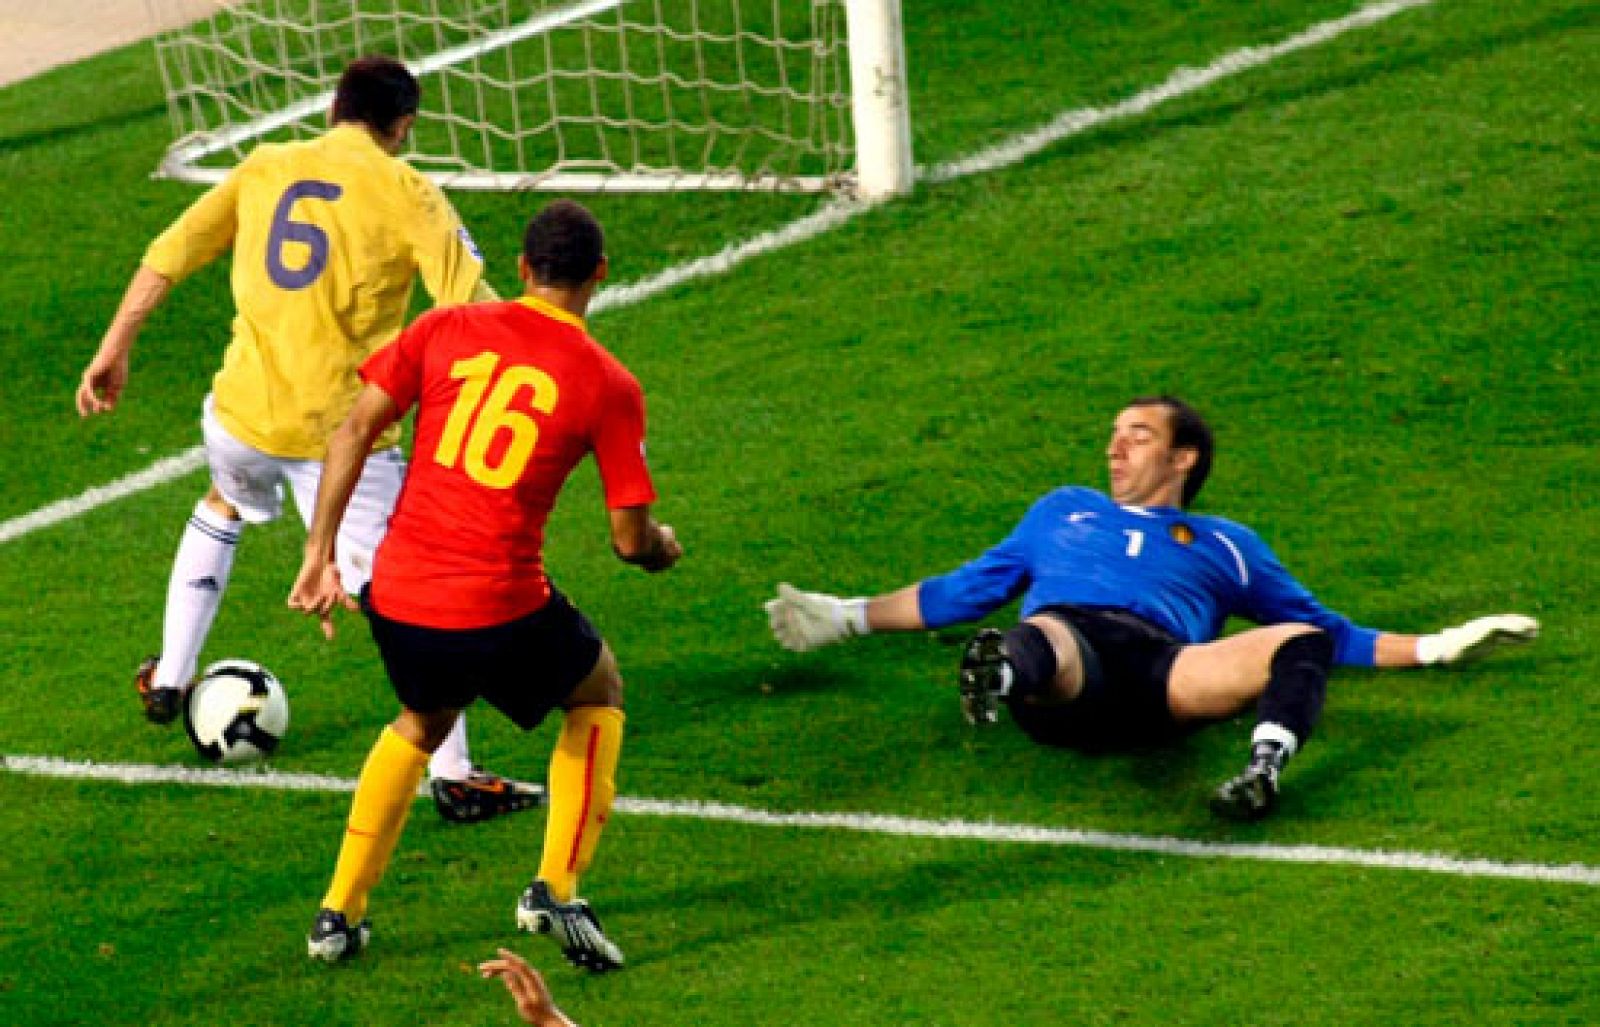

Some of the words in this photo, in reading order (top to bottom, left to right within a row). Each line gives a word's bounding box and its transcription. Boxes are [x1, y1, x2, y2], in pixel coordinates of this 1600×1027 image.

[266, 180, 342, 290] 6
[433, 351, 559, 490] 16
[1123, 529, 1145, 557] 1
